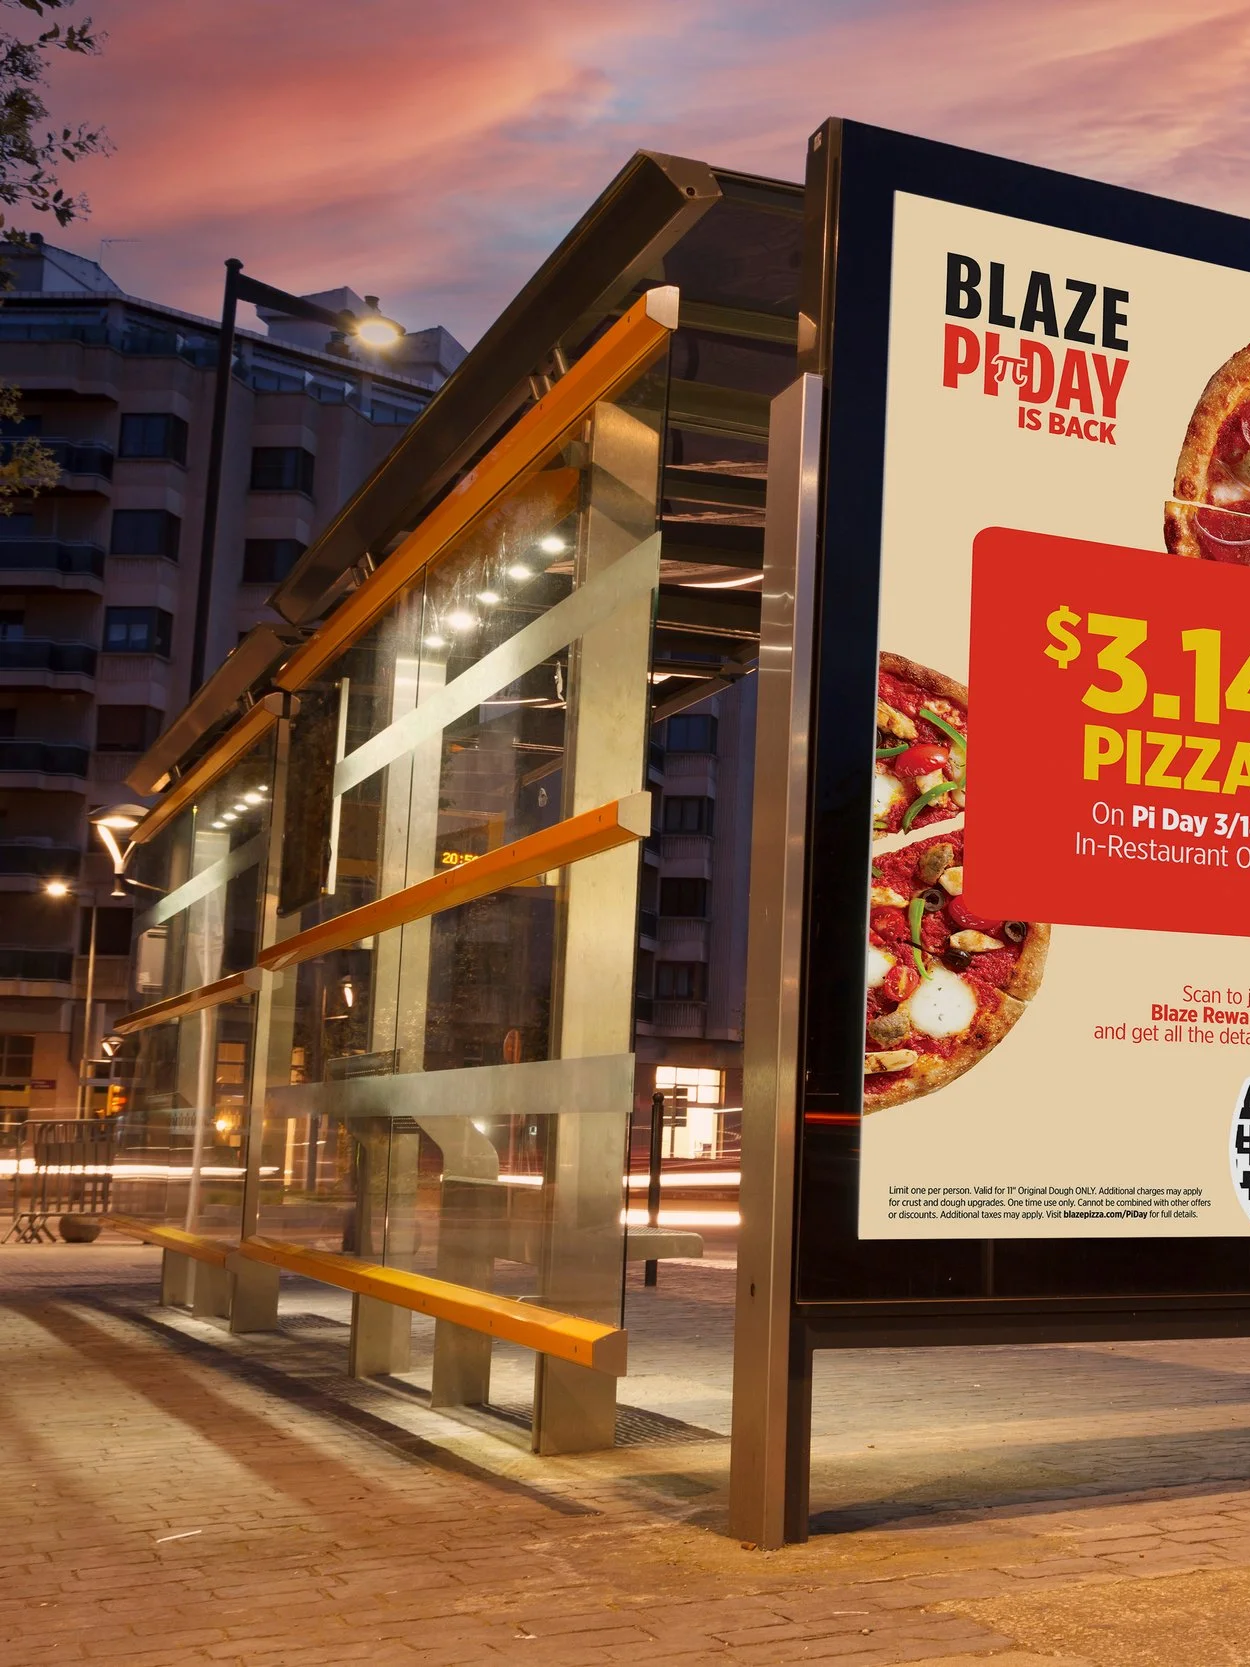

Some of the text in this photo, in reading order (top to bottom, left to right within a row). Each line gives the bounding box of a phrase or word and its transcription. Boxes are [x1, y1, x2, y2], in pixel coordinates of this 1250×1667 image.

[945, 252, 1129, 352] BLAZE
[1018, 406, 1117, 445] IS BACK
[1092, 801, 1124, 826] On
[1132, 805, 1156, 829] Pi
[1162, 808, 1208, 837] Day
[1076, 832, 1228, 867] In-Restaurant
[1183, 985, 1221, 1003] Scan
[1226, 988, 1243, 1004] to
[1151, 1004, 1198, 1023] Blaze
[1094, 1023, 1126, 1040] and
[1131, 1025, 1159, 1044] get
[1164, 1026, 1182, 1042] all
[1188, 1027, 1214, 1043] the
[889, 1186, 909, 1195] Limit
[928, 1188, 941, 1197] per
[943, 1188, 971, 1197] person.
[974, 1186, 992, 1195] Valid
[995, 1186, 1005, 1195] for
[1018, 1186, 1047, 1197] Original
[1049, 1186, 1073, 1197] Dough
[1075, 1186, 1097, 1195] ONLY.
[1099, 1186, 1135, 1195] Additional
[1137, 1186, 1164, 1197] charges
[1166, 1188, 1181, 1197] may
[1183, 1186, 1203, 1197] apply
[889, 1198, 900, 1207] for
[902, 1198, 921, 1207] crust
[923, 1198, 938, 1207] and
[940, 1198, 966, 1209] dough
[968, 1198, 1005, 1209] upgrades.
[1008, 1198, 1023, 1207] One
[1025, 1198, 1042, 1207] time
[1058, 1198, 1075, 1209] only.
[1078, 1198, 1103, 1207] Cannot
[1106, 1198, 1115, 1207] be
[1116, 1198, 1152, 1207] combined
[1154, 1198, 1169, 1207] with
[1170, 1198, 1189, 1207] other
[1191, 1198, 1211, 1207] offers
[899, 1210, 938, 1219] discounts.
[940, 1210, 979, 1219] Additional
[982, 1210, 1002, 1219] taxes
[1003, 1212, 1020, 1220] may
[1022, 1210, 1044, 1220] apply.
[1046, 1210, 1062, 1219] Visit
[1064, 1210, 1147, 1220] blazepizza.com/PiDay
[1149, 1210, 1159, 1219] for
[1161, 1210, 1172, 1219] full
[1173, 1210, 1198, 1219] details.
